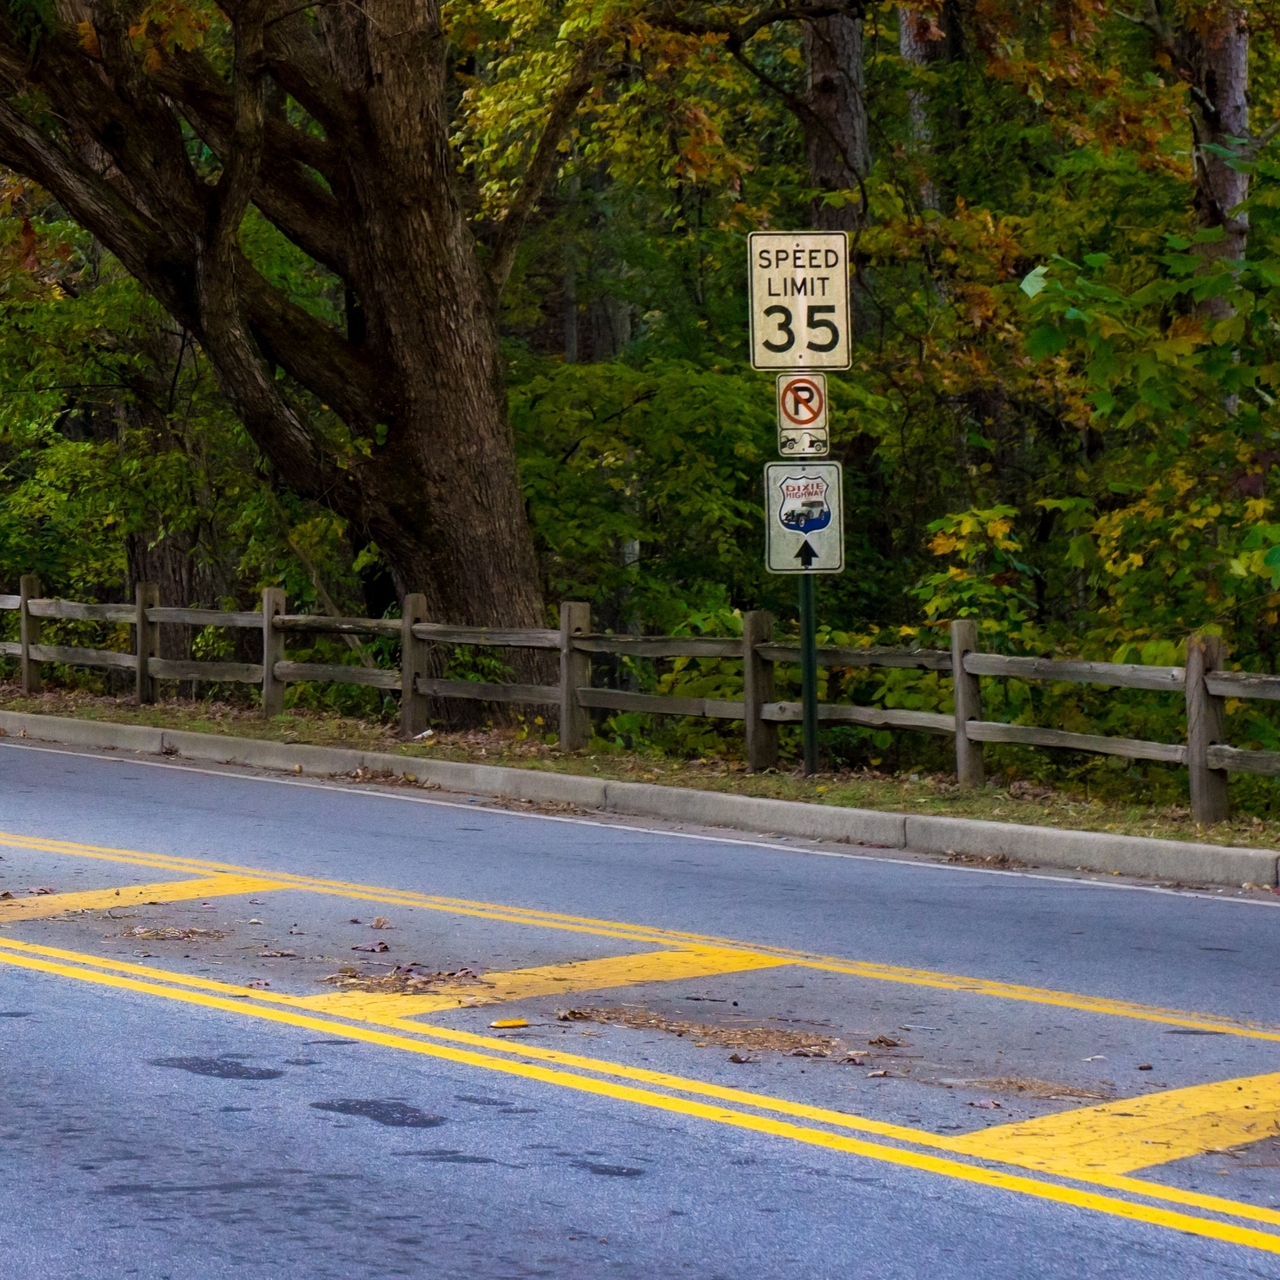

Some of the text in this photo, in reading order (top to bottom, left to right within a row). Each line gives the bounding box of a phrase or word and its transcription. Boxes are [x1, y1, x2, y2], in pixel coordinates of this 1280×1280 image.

[758, 249, 839, 269] SPEED
[767, 276, 830, 297] LIMIT
[761, 304, 840, 354] 35
[792, 386, 815, 416] P
[785, 483, 823, 492] DIXIE
[786, 490, 823, 498] HIGHWAY
